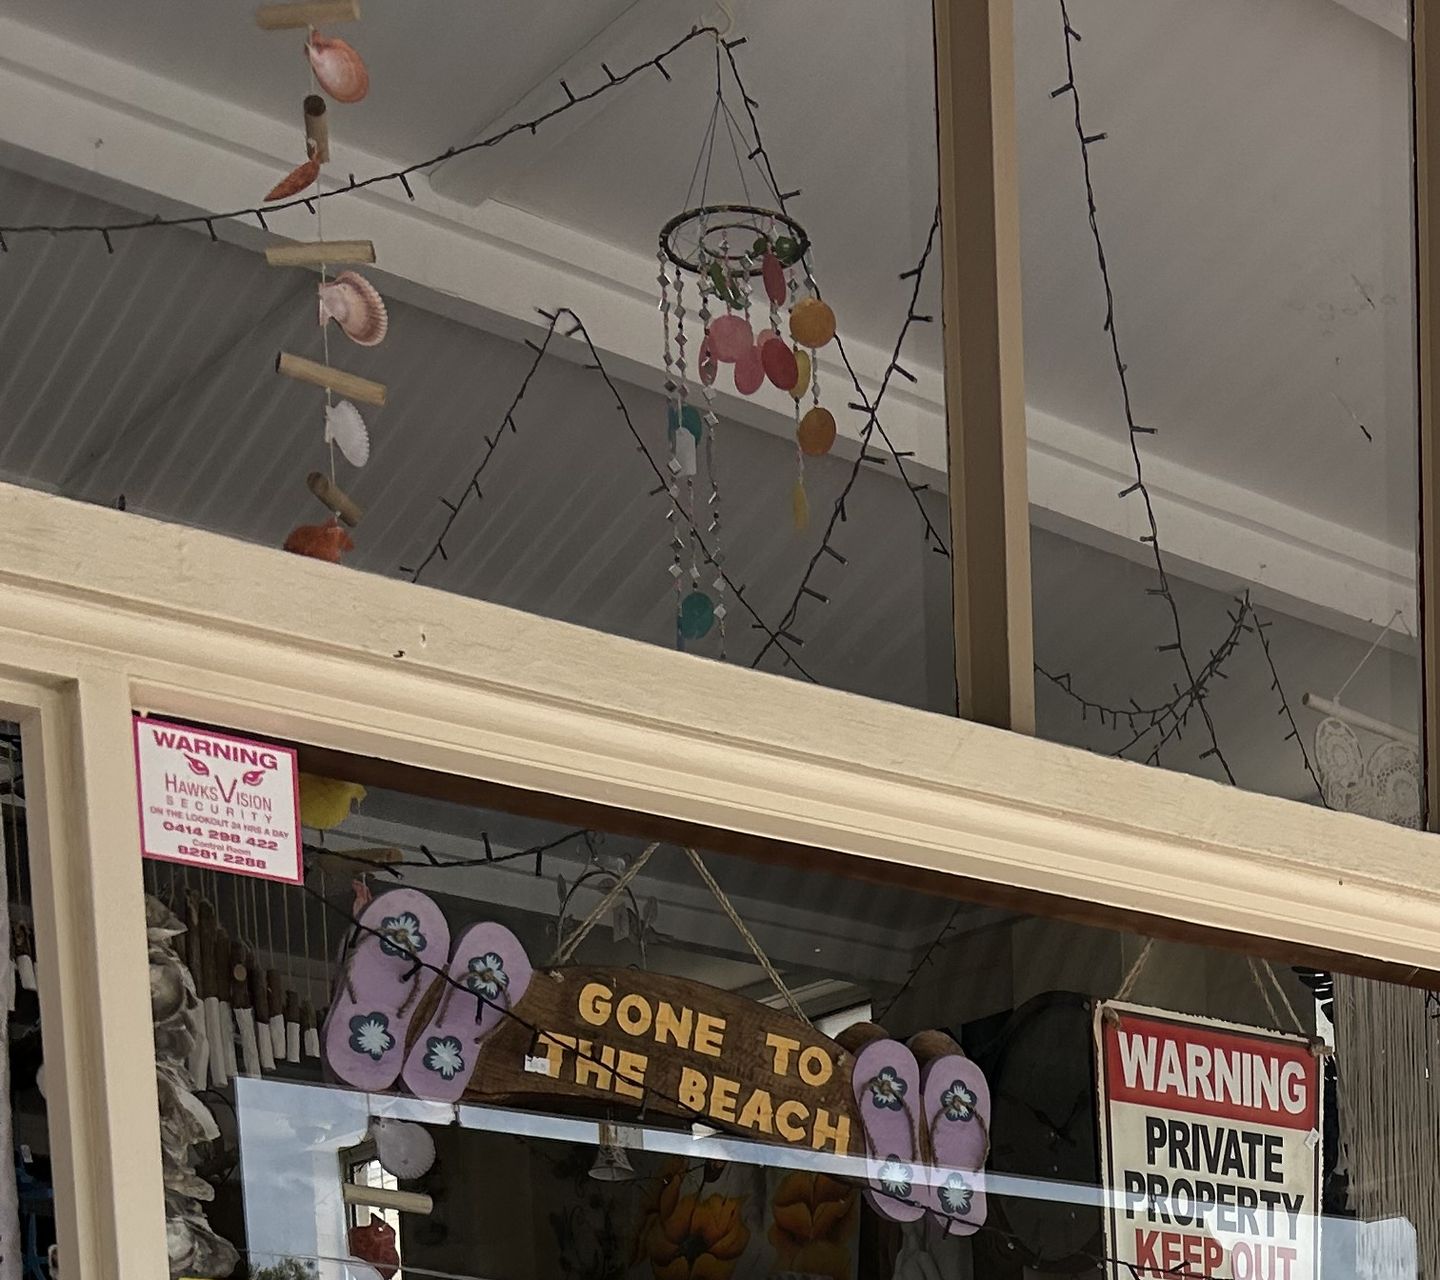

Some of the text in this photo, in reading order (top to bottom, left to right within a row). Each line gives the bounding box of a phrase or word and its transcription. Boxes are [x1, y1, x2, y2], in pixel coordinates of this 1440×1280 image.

[153, 729, 278, 770] WARNING
[150, 806, 163, 816] ON
[166, 808, 183, 819] THE
[186, 813, 229, 828] LOOKOUT
[243, 822, 261, 834] HRS
[272, 829, 289, 839] DAY
[162, 821, 203, 836] 0414
[245, 836, 278, 851] 422
[166, 795, 272, 824] SECURITY
[192, 839, 224, 851] Control
[578, 983, 833, 1087] GONE TO
[538, 1030, 850, 1157] THE BEACH
[1117, 1030, 1307, 1114] WARNING
[1146, 1115, 1284, 1184] PRIVATE
[1124, 1170, 1304, 1240] PROPERTY
